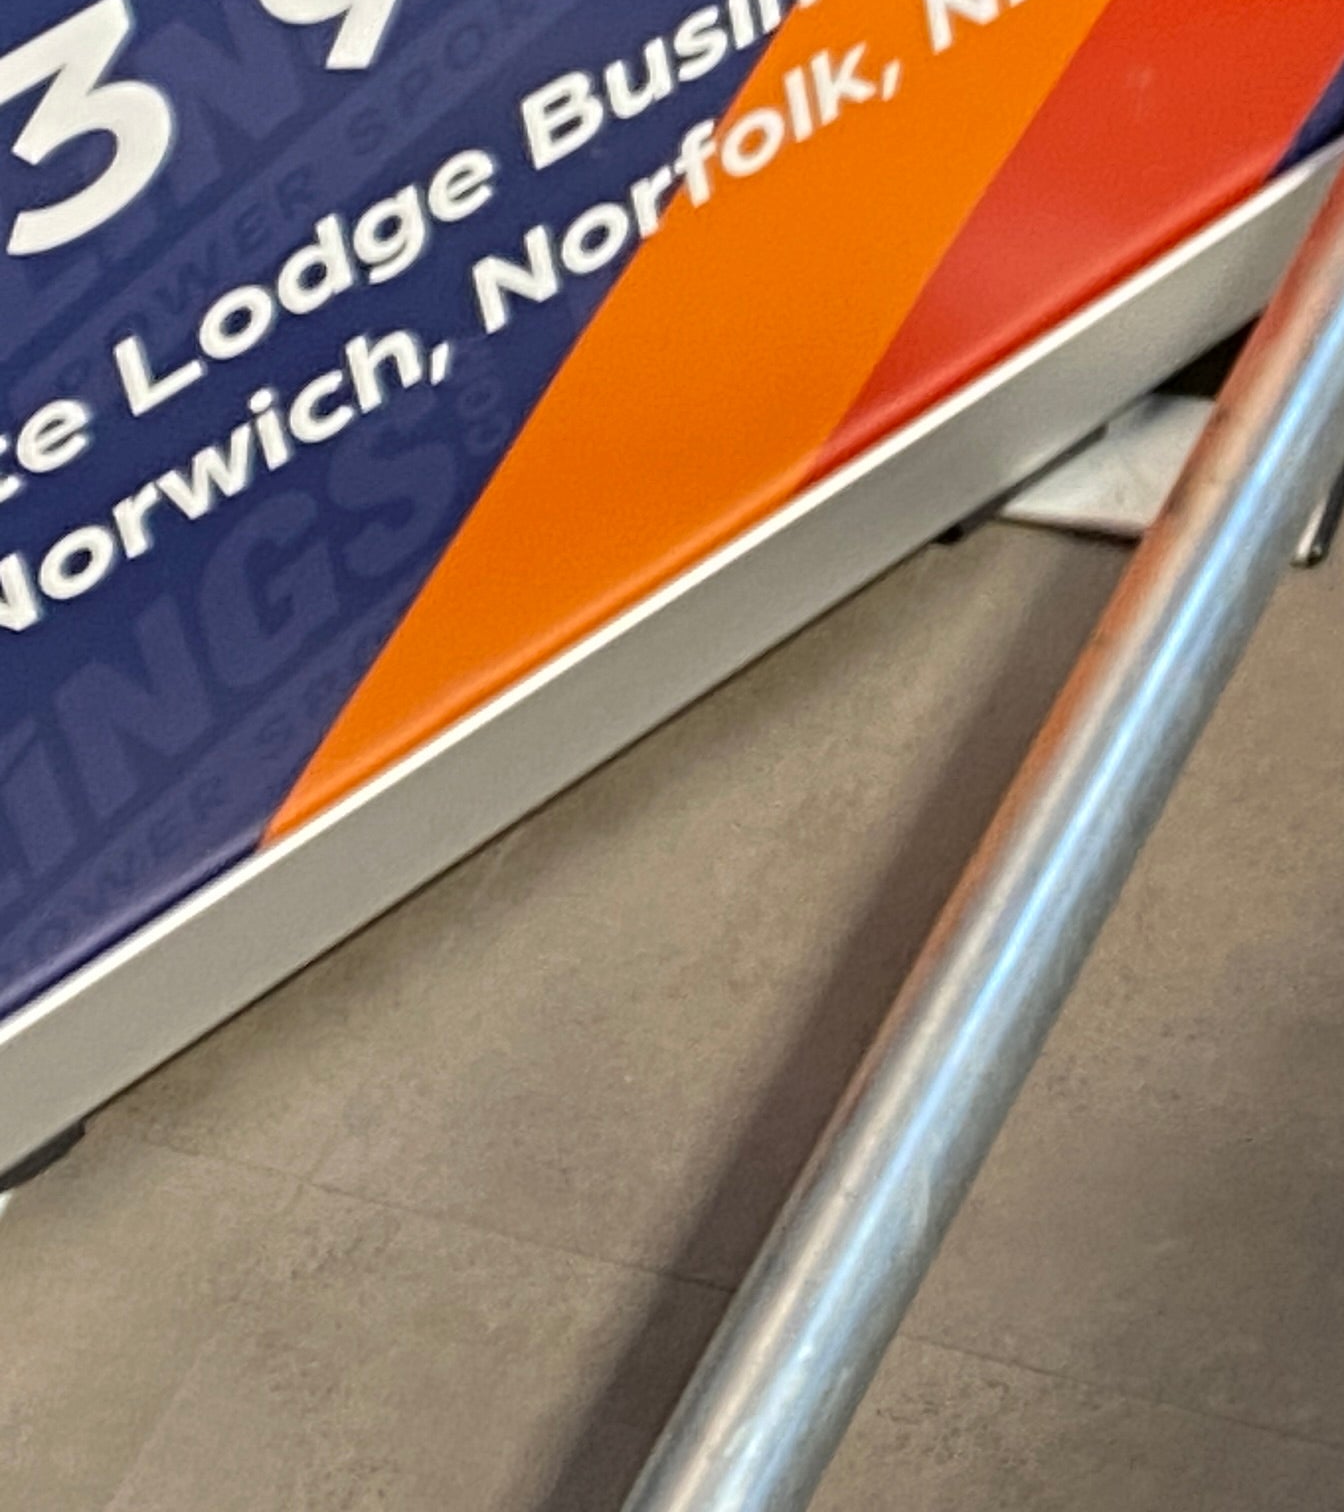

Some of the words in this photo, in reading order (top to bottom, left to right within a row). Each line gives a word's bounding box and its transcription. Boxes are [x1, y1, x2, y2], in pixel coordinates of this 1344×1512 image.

[0, 399, 90, 504] e
[114, 149, 497, 417] Lodge
[472, 40, 902, 334] Norfolk,
